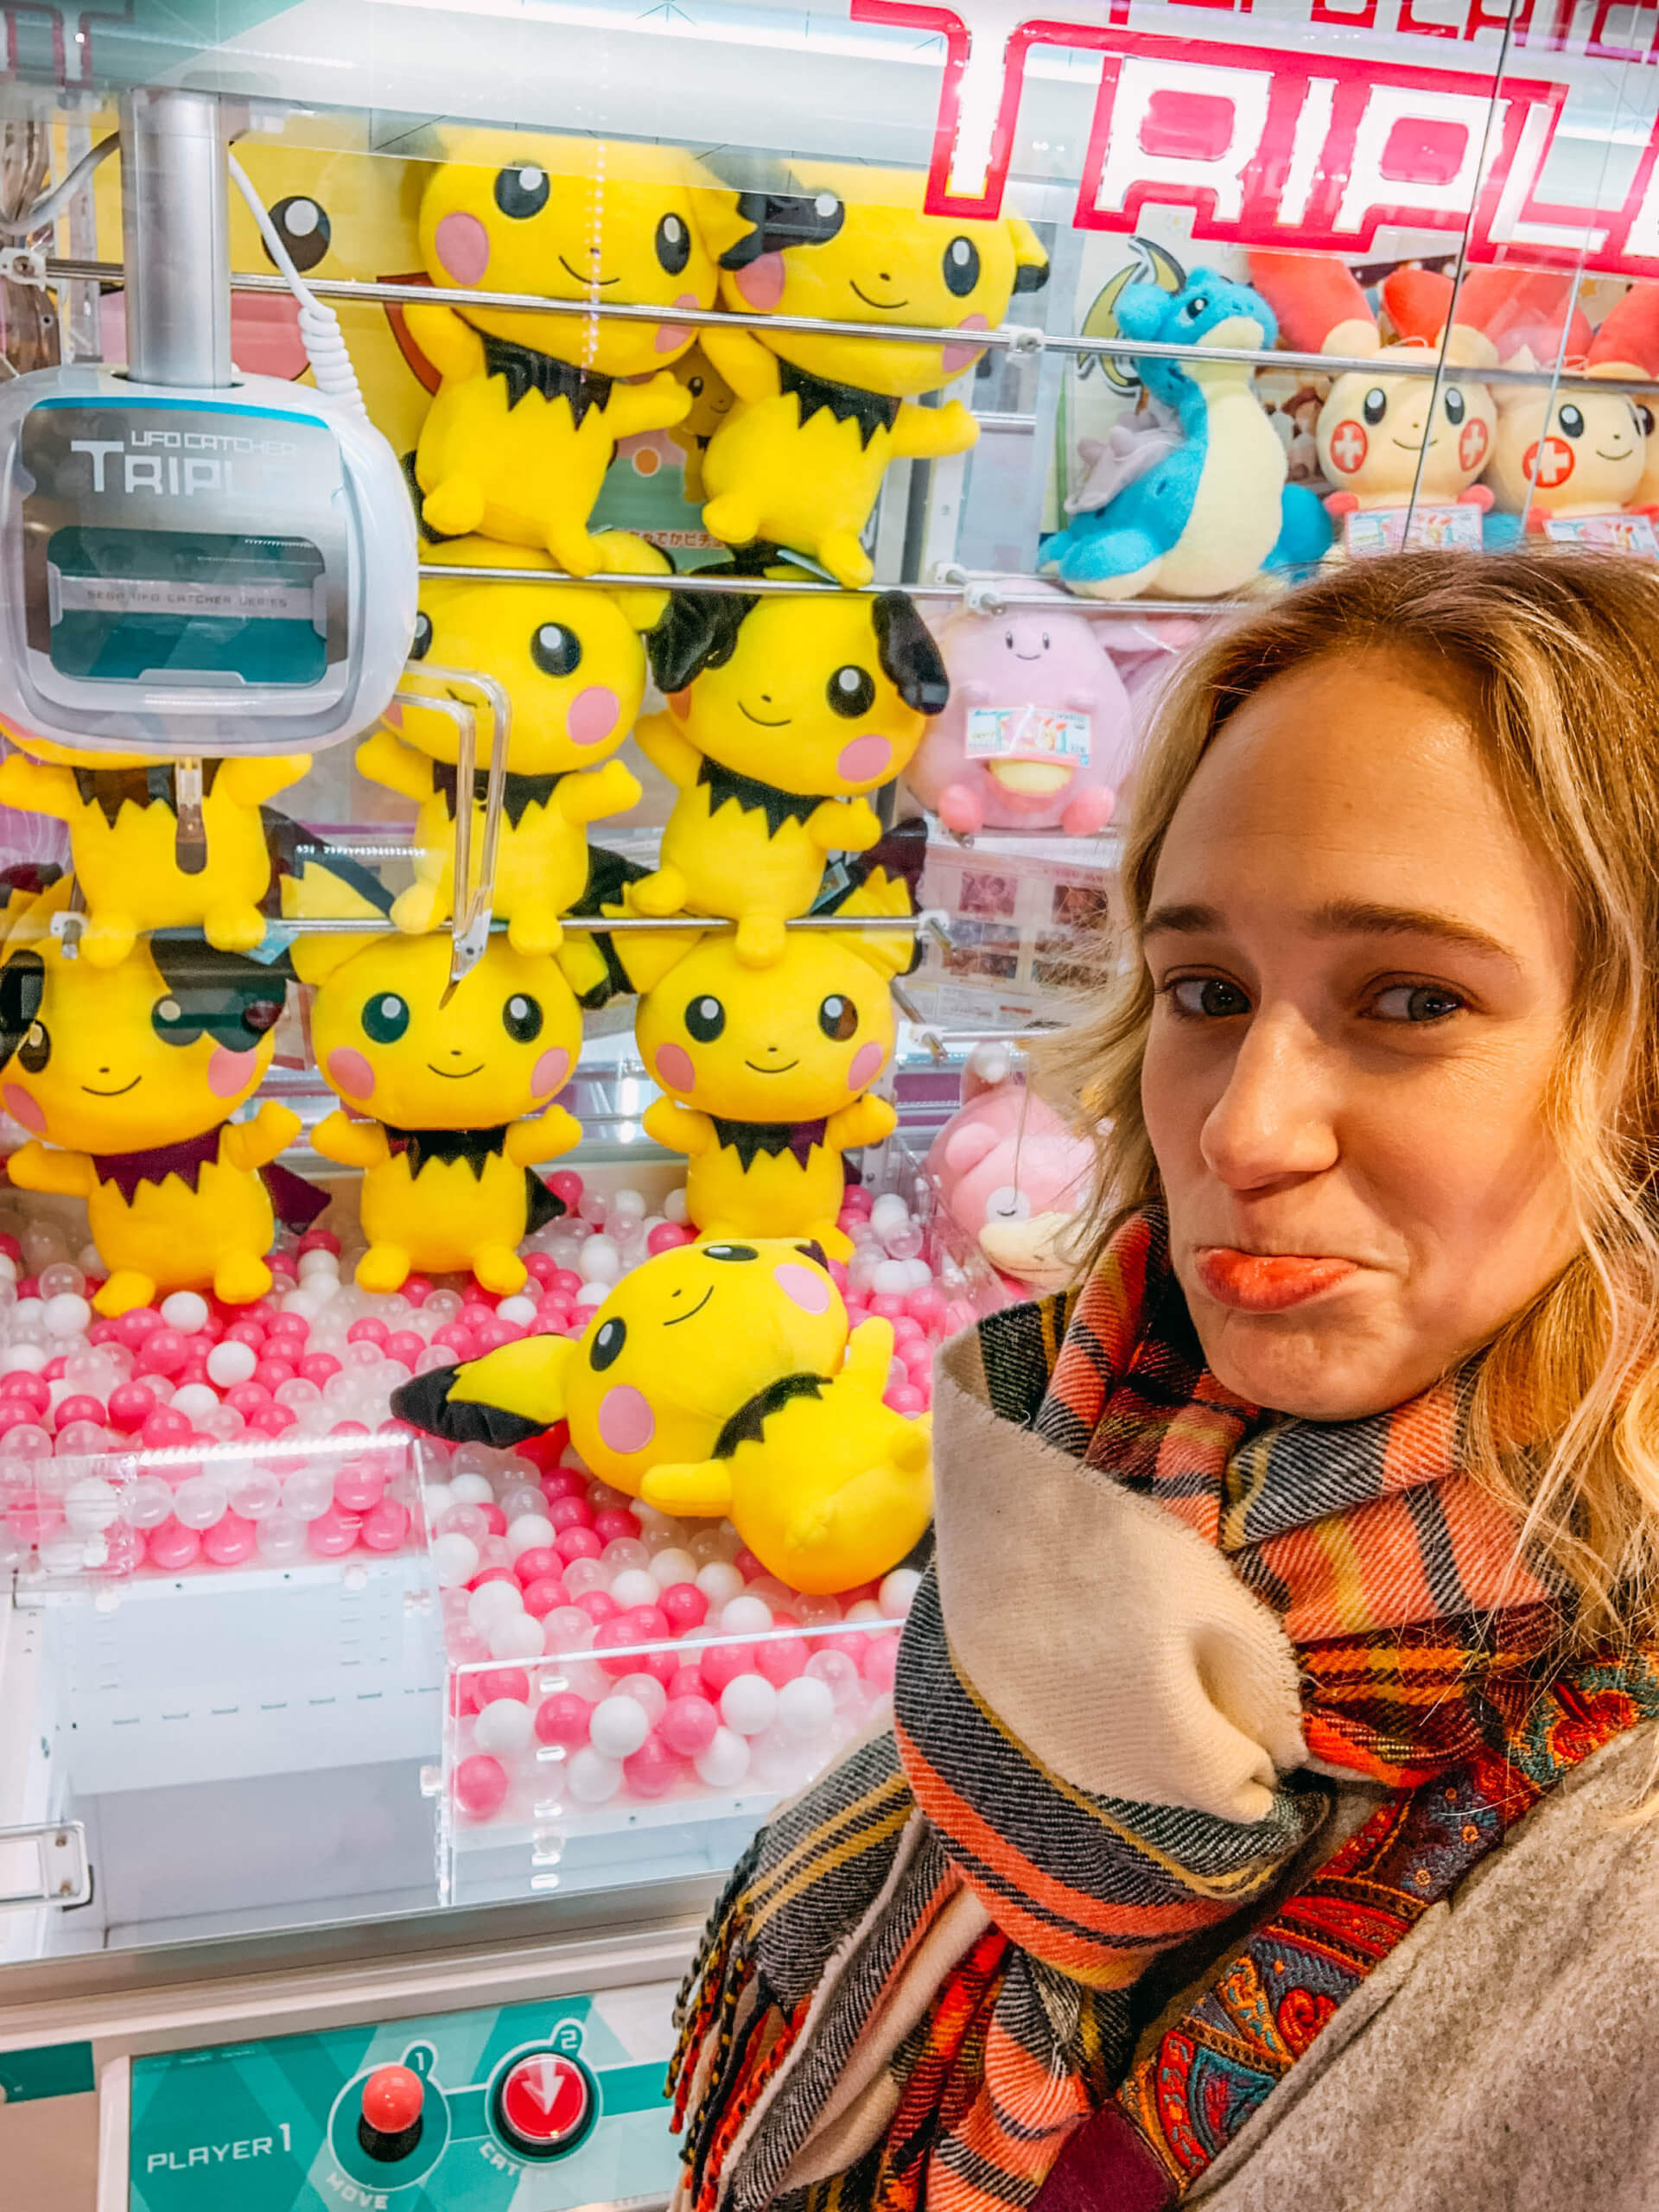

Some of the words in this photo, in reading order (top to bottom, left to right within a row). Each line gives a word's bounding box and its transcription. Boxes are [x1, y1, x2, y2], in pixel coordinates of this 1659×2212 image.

[71, 440, 298, 498] TRIPL
[561, 2030, 579, 2050] 2
[415, 2051, 425, 2072] 1
[147, 2136, 273, 2174] PLAYER
[277, 2122, 292, 2152] 1
[325, 2171, 389, 2210] MOVE
